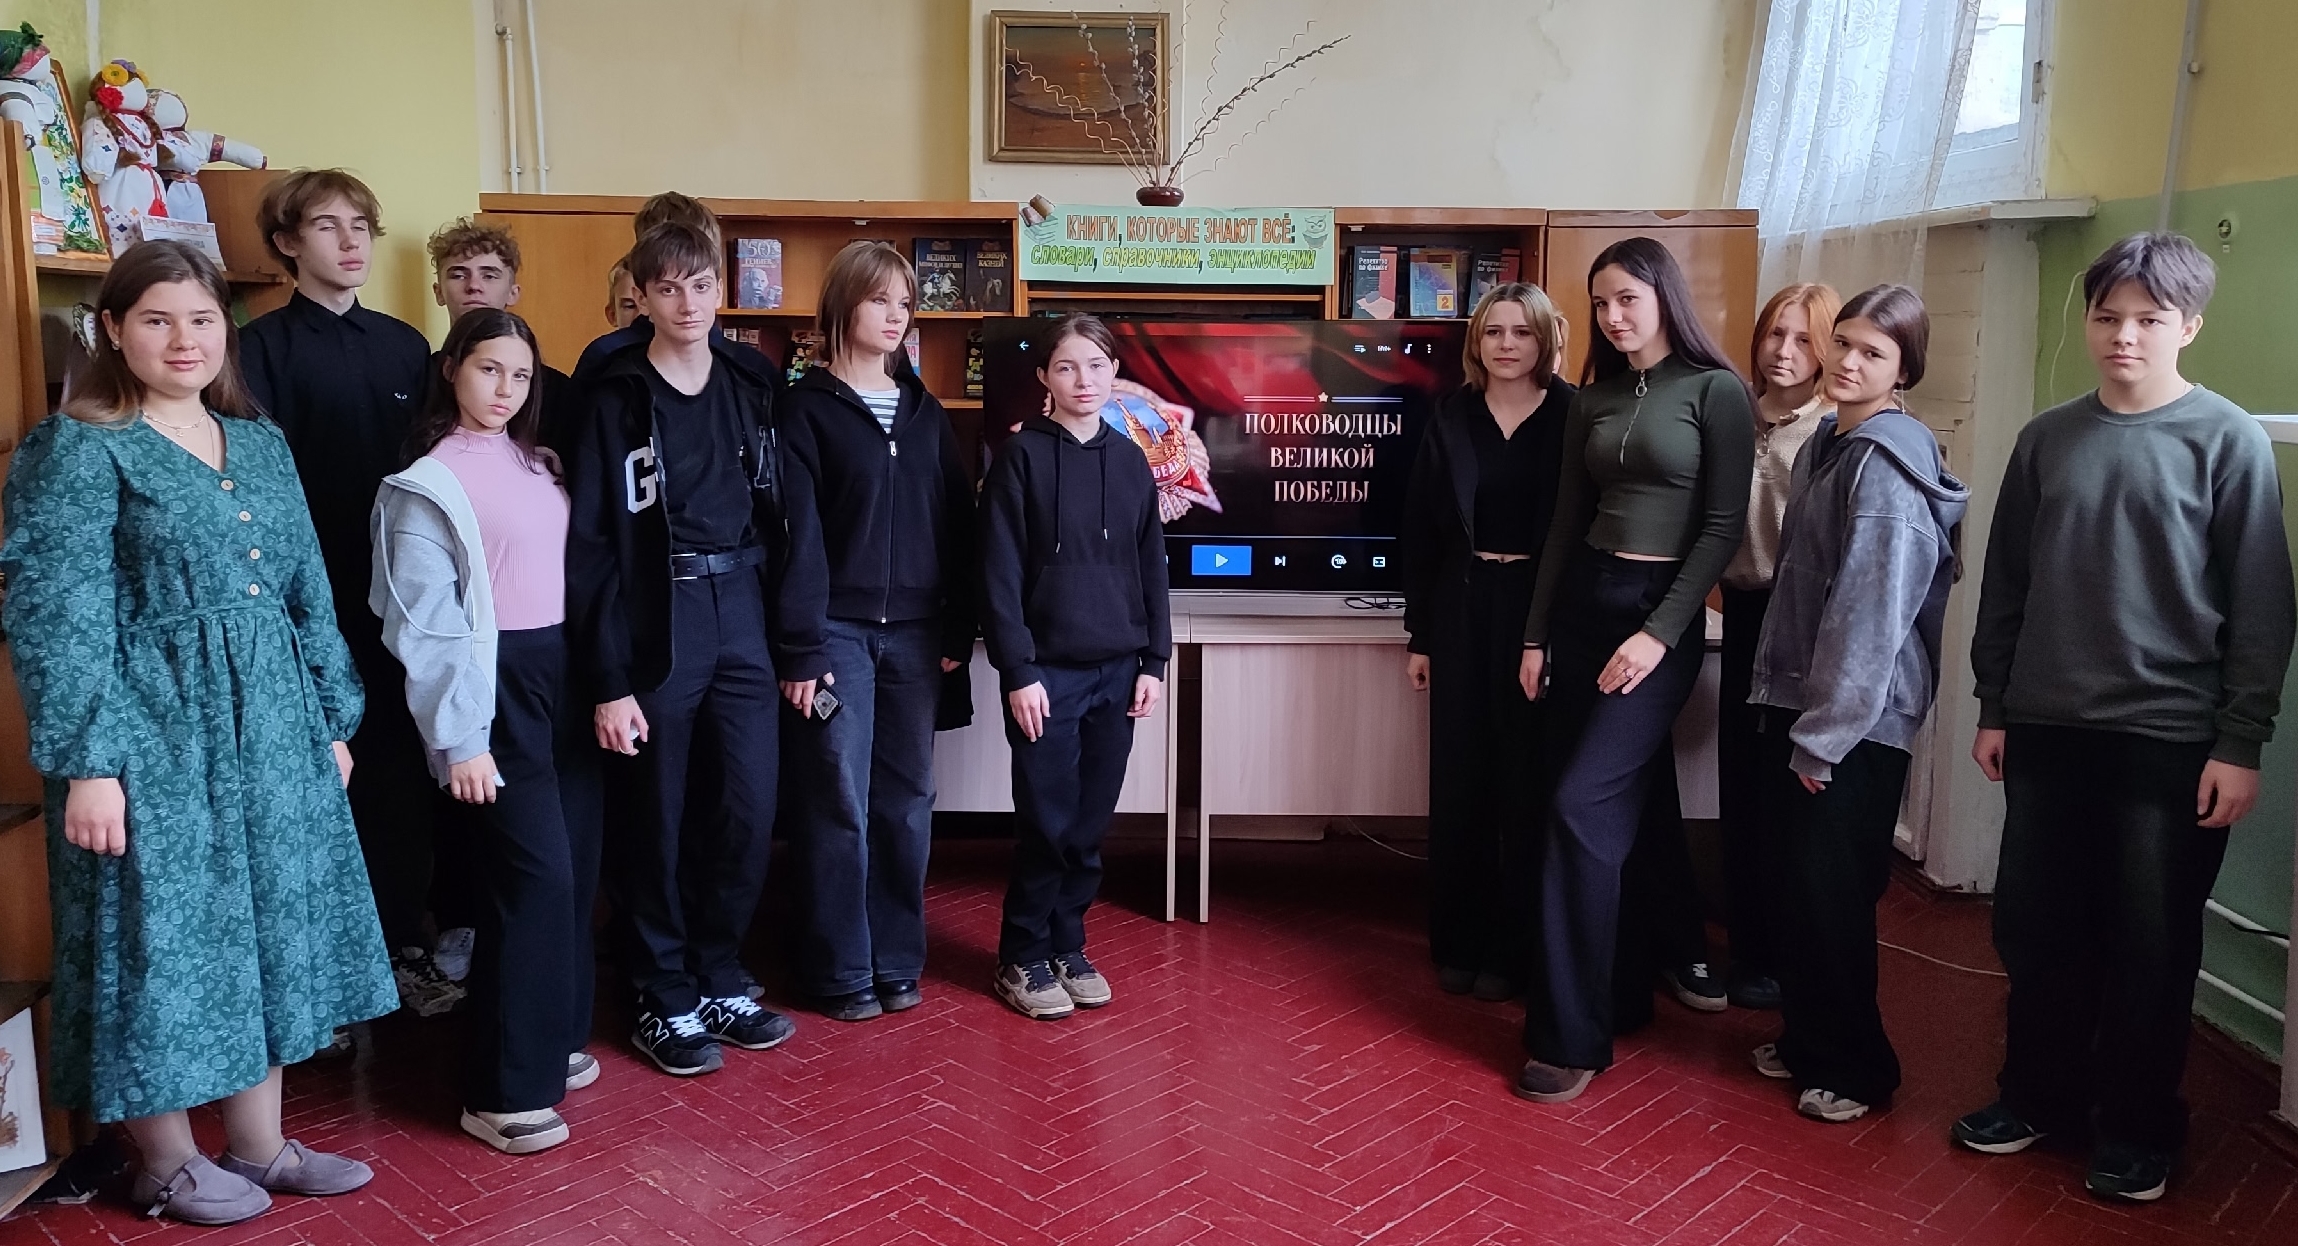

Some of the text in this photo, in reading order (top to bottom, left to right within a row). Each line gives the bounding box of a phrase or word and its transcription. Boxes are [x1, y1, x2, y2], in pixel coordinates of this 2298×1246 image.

[1066, 213, 1296, 248] КНИГИ, КОТОРЫЕ ЗНАЮТ ВСЁ:
[1031, 245, 1316, 274] словари, справочники, энциклопедии
[1441, 296, 1450, 310] 2
[1244, 413, 1403, 438] ПОЛКОВОДЦЫ
[1270, 443, 1375, 468] ВЕЛИКОЙ
[1274, 481, 1370, 504] ПОБЕДЫ
